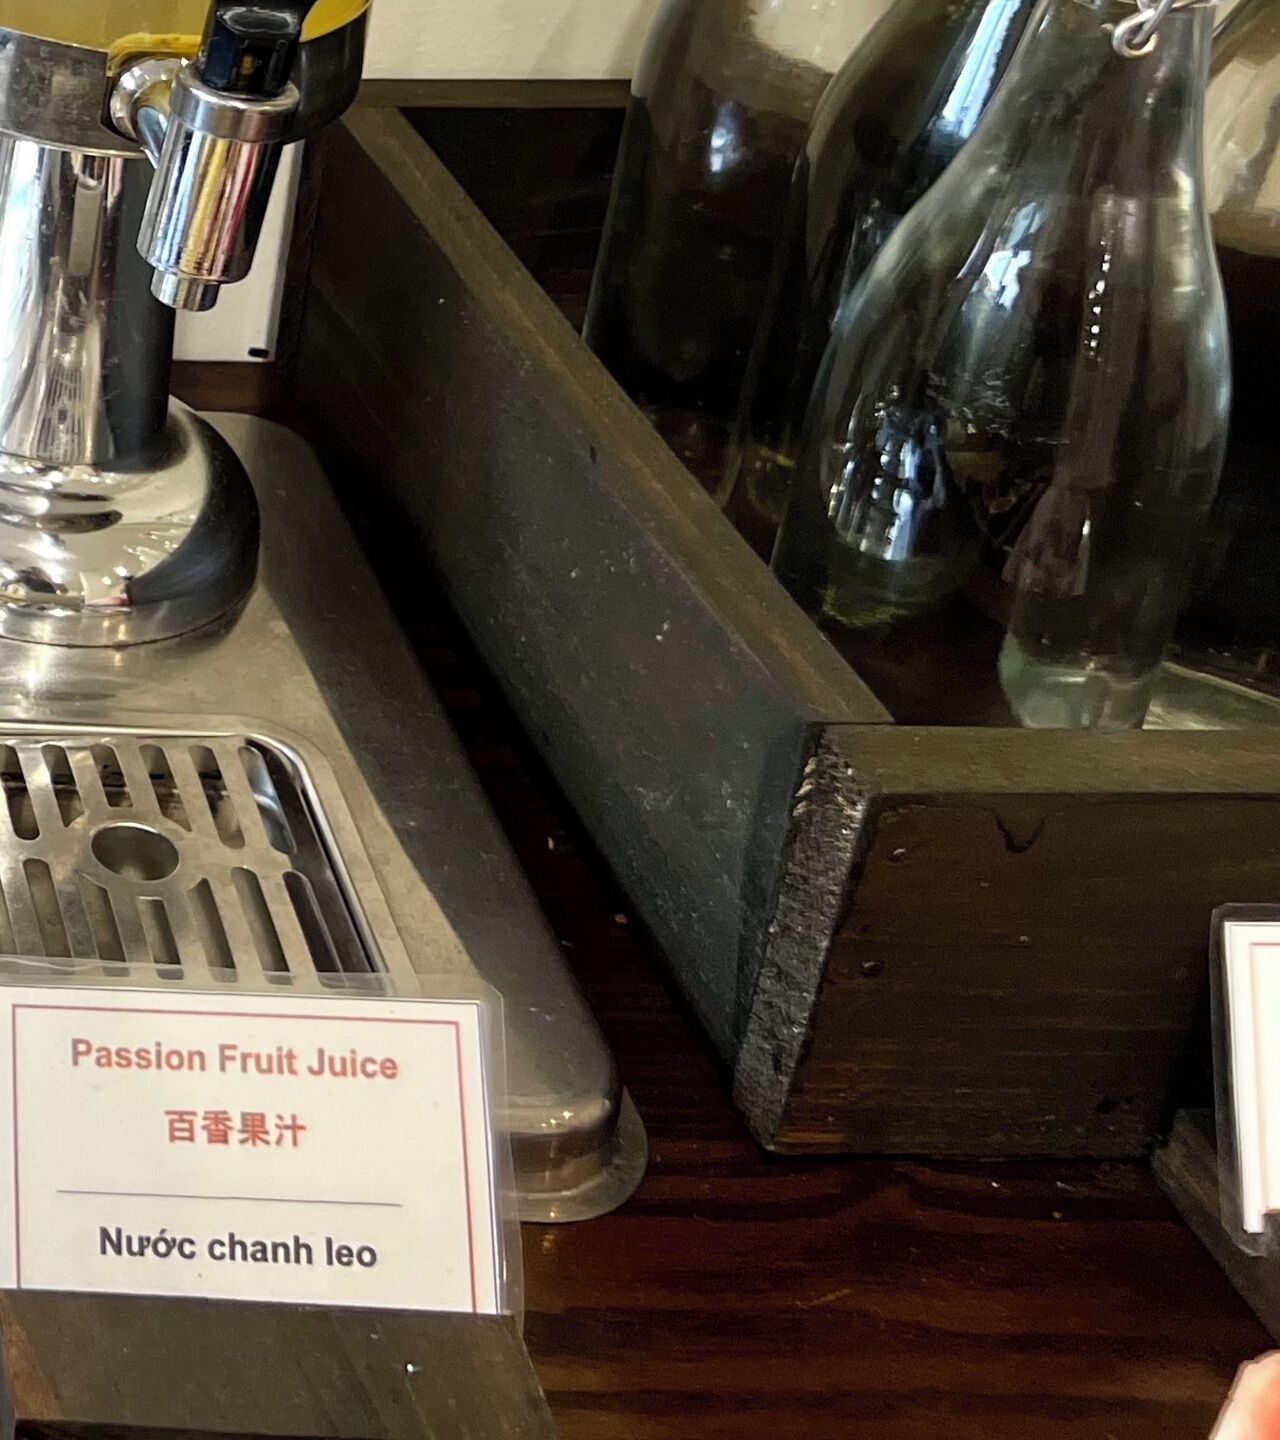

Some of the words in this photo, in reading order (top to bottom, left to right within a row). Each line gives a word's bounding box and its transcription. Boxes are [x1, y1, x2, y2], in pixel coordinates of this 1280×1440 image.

[71, 1037, 206, 1072] Passion
[218, 1043, 299, 1076] Fruit
[307, 1047, 399, 1080] Juice
[164, 1109, 307, 1148] 百香果汁
[99, 1225, 197, 1261] Nước
[207, 1231, 314, 1266] chanh
[324, 1236, 378, 1269] leo
